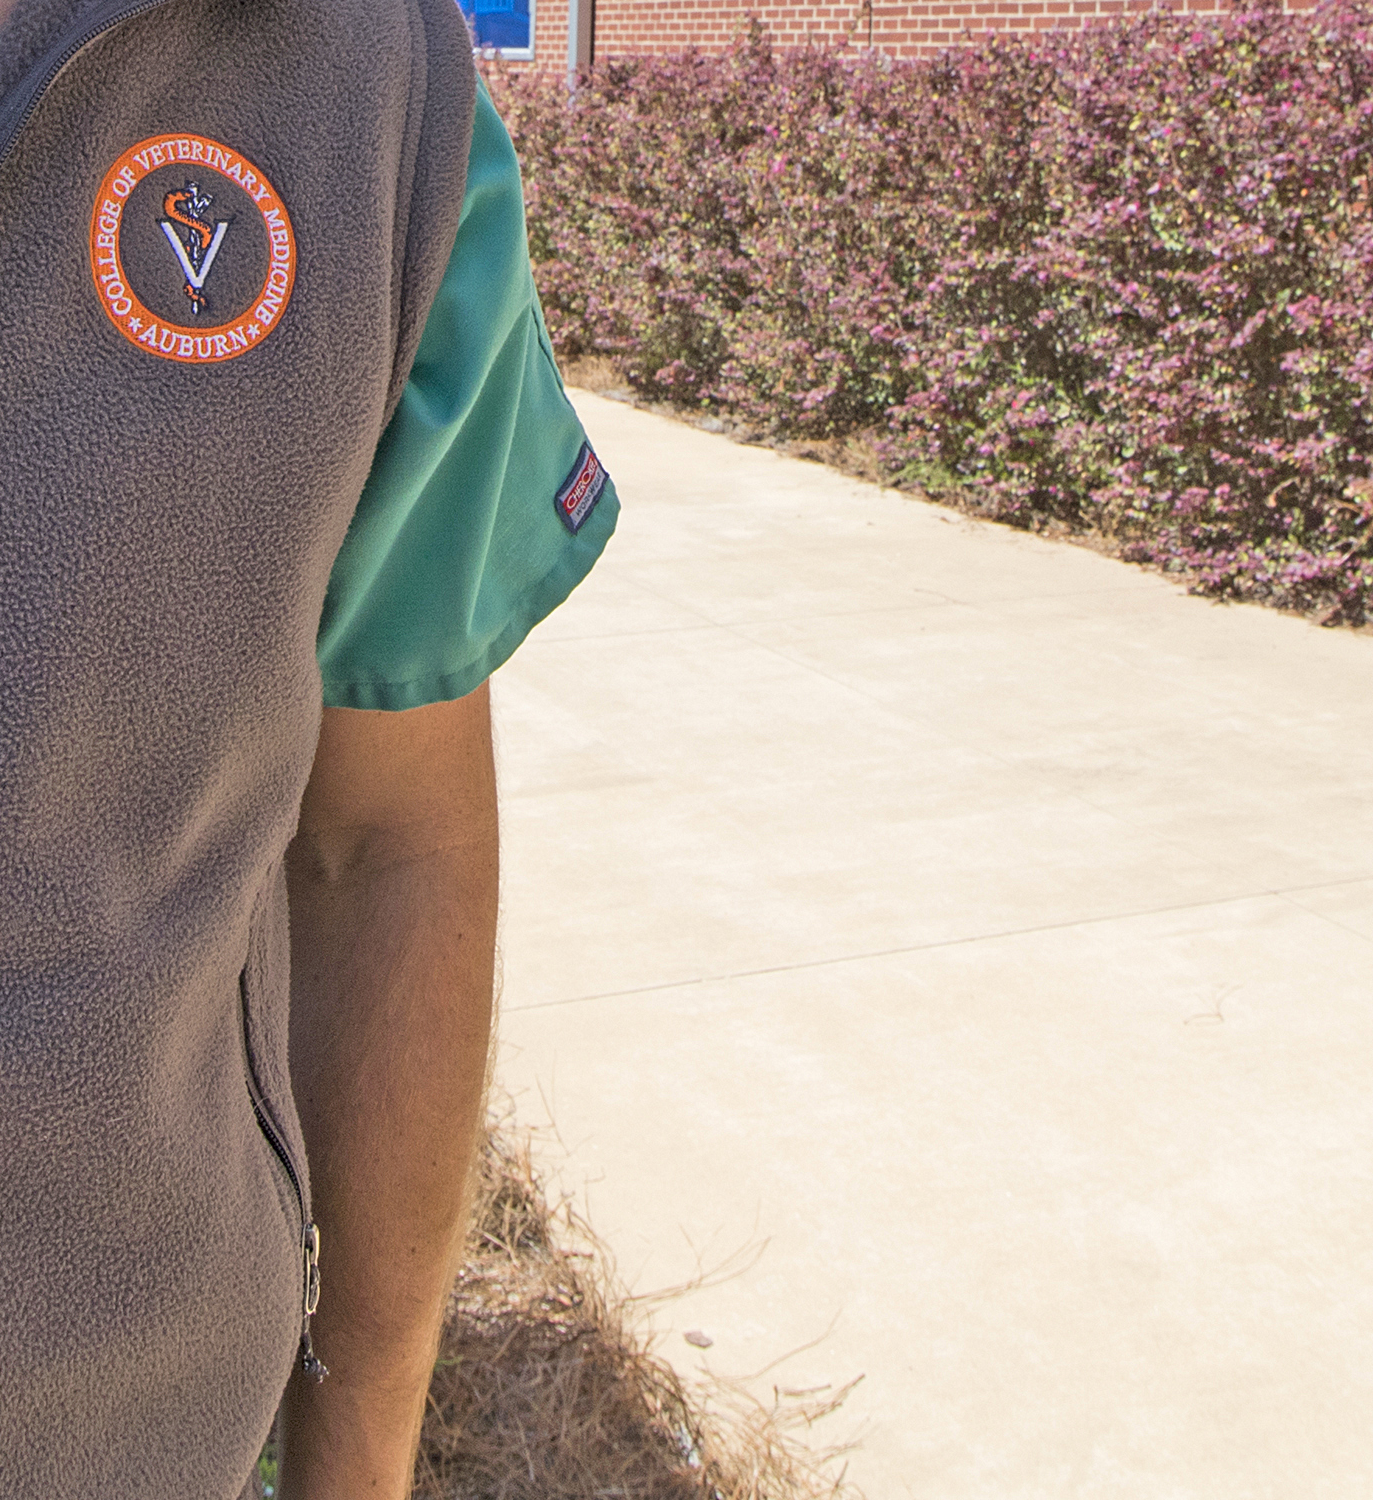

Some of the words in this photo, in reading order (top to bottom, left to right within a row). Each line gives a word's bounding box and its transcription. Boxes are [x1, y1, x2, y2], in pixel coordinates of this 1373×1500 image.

[112, 165, 138, 199] OF
[133, 139, 271, 202] VETERINARY
[97, 198, 132, 316] COLLEGE
[253, 207, 291, 327] MEDICINE
[138, 324, 249, 359] AUBURN
